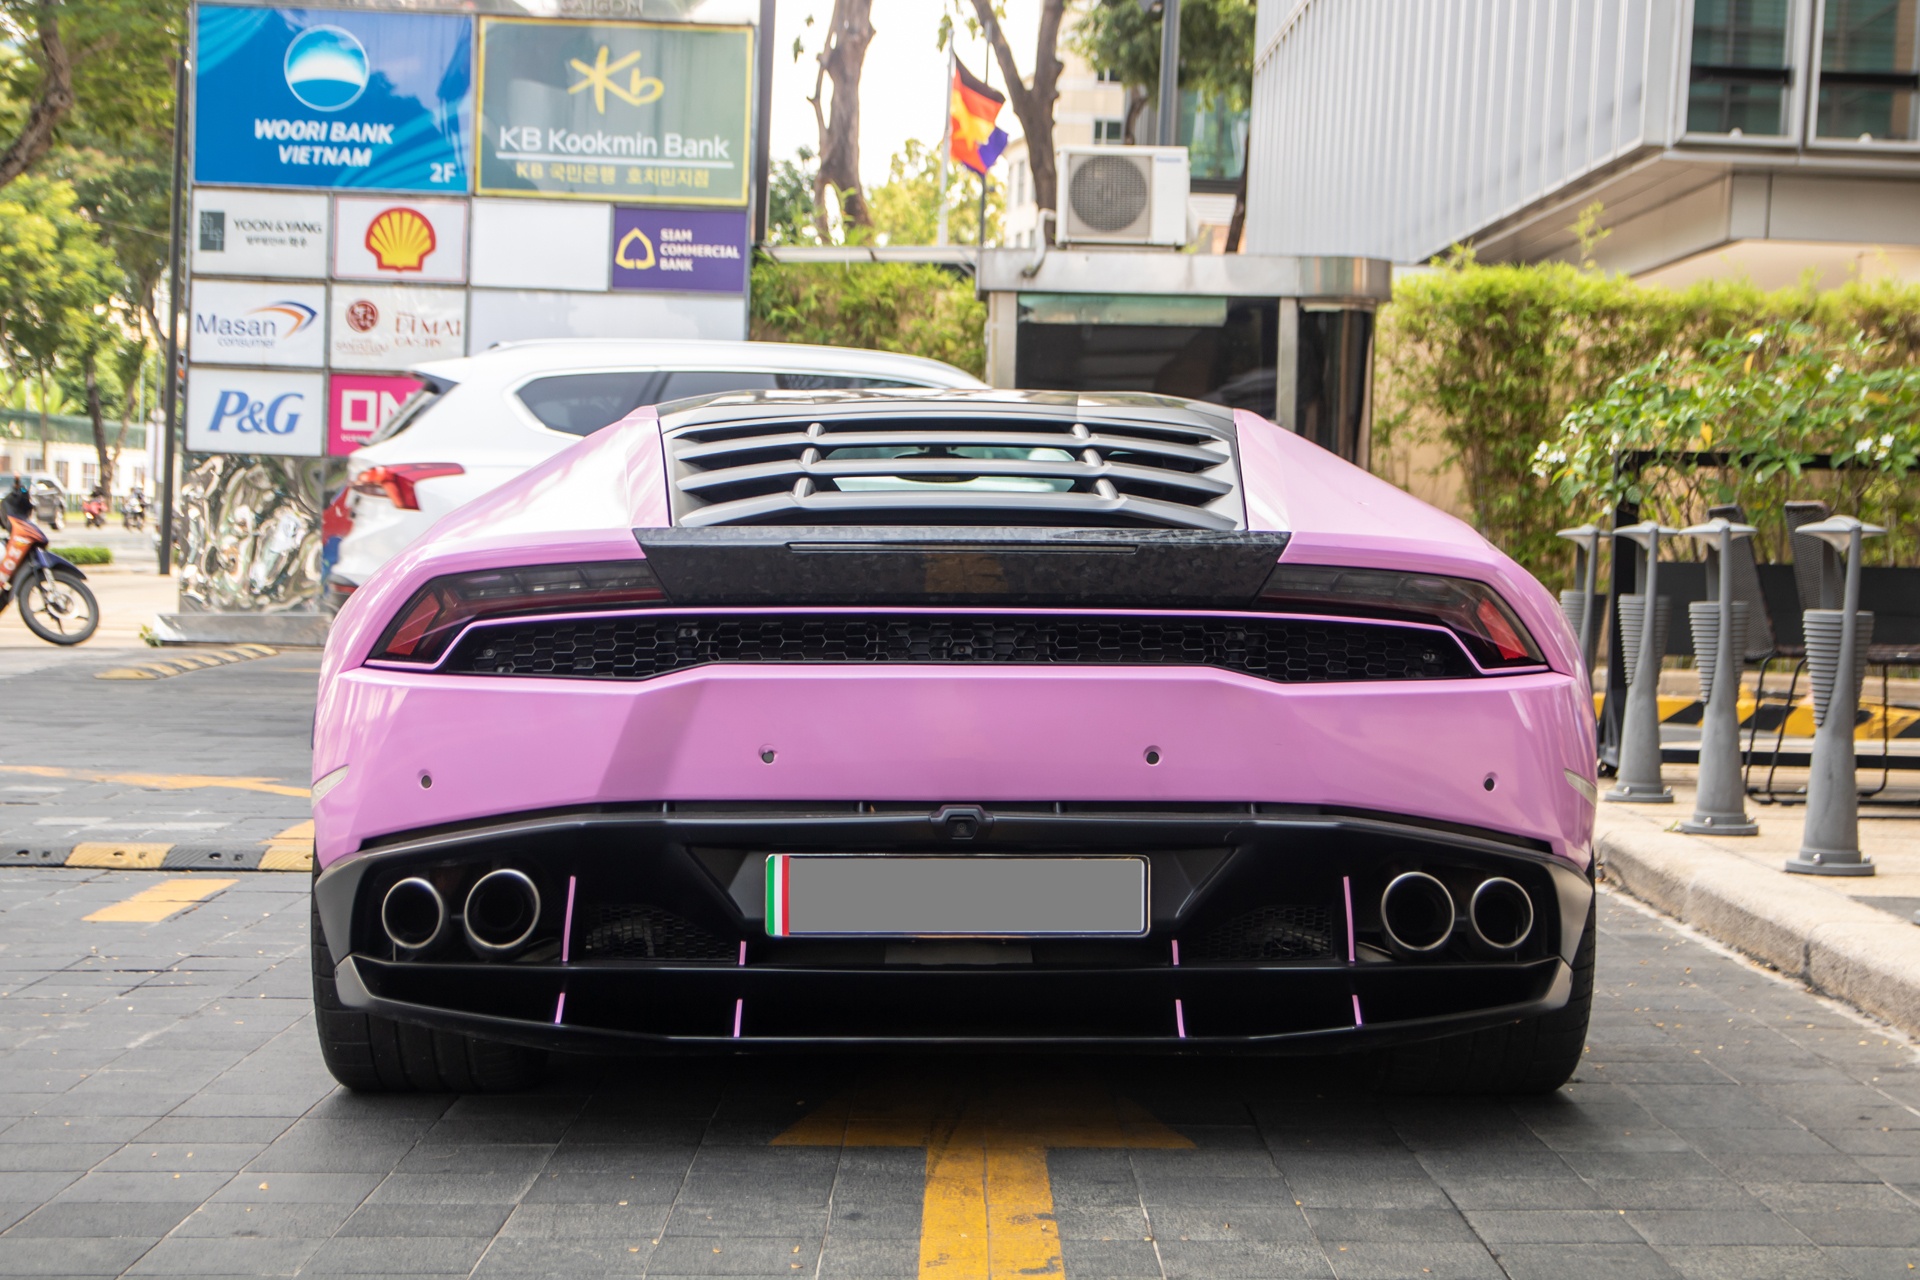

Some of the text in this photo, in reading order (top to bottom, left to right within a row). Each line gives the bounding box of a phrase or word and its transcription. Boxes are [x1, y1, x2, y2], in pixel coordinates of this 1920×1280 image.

[254, 118, 395, 144] WOORI BANK
[500, 126, 730, 159] KB Kookmin Bank
[278, 144, 372, 167] VIETNAM
[429, 162, 456, 183] 2F
[516, 162, 544, 179] KB
[233, 218, 322, 234] YOON & YANG
[660, 228, 692, 242] SIAM
[660, 243, 740, 259] COMMERCIAL
[660, 258, 693, 271] BANK
[196, 313, 276, 336] Masan
[217, 337, 275, 348] consumer
[207, 389, 304, 436] P&G
[341, 390, 417, 431] ON
